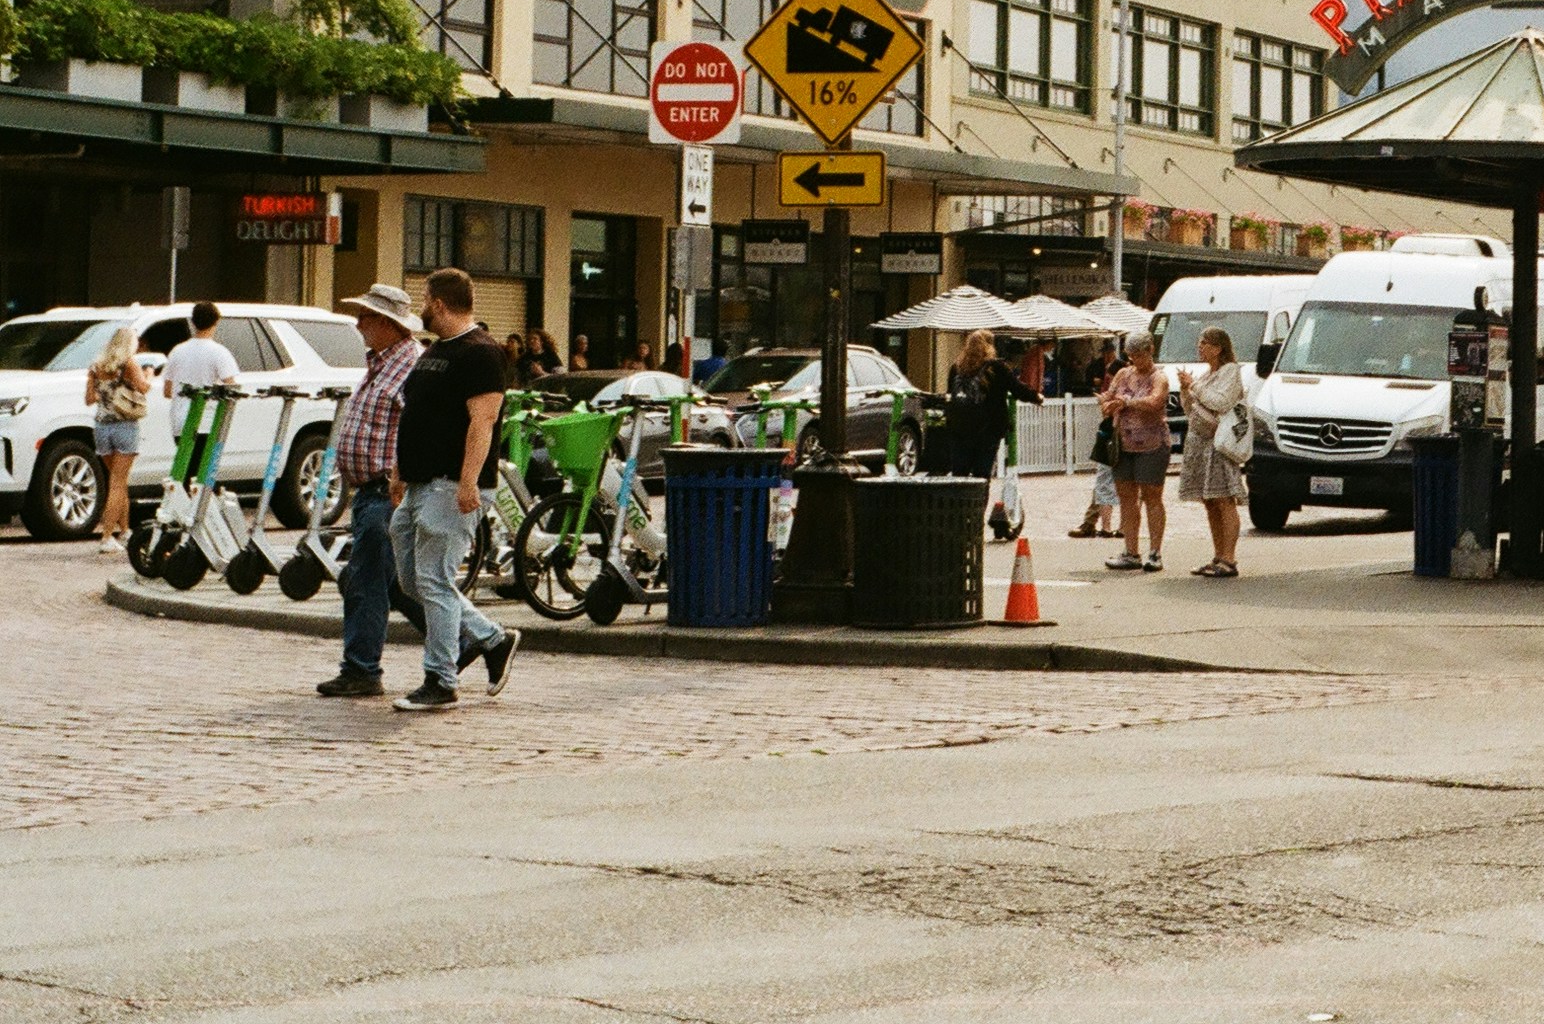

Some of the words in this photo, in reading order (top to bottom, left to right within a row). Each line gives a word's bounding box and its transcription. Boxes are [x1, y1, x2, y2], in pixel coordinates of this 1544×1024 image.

[665, 63, 686, 78] DO
[695, 63, 727, 78] NOT
[810, 80, 857, 105] 16%
[670, 107, 719, 123] ENTER
[688, 152, 708, 172] ONE
[687, 175, 708, 193] WAY
[243, 195, 316, 215] TURKISH
[237, 220, 322, 240] DELIGHT
